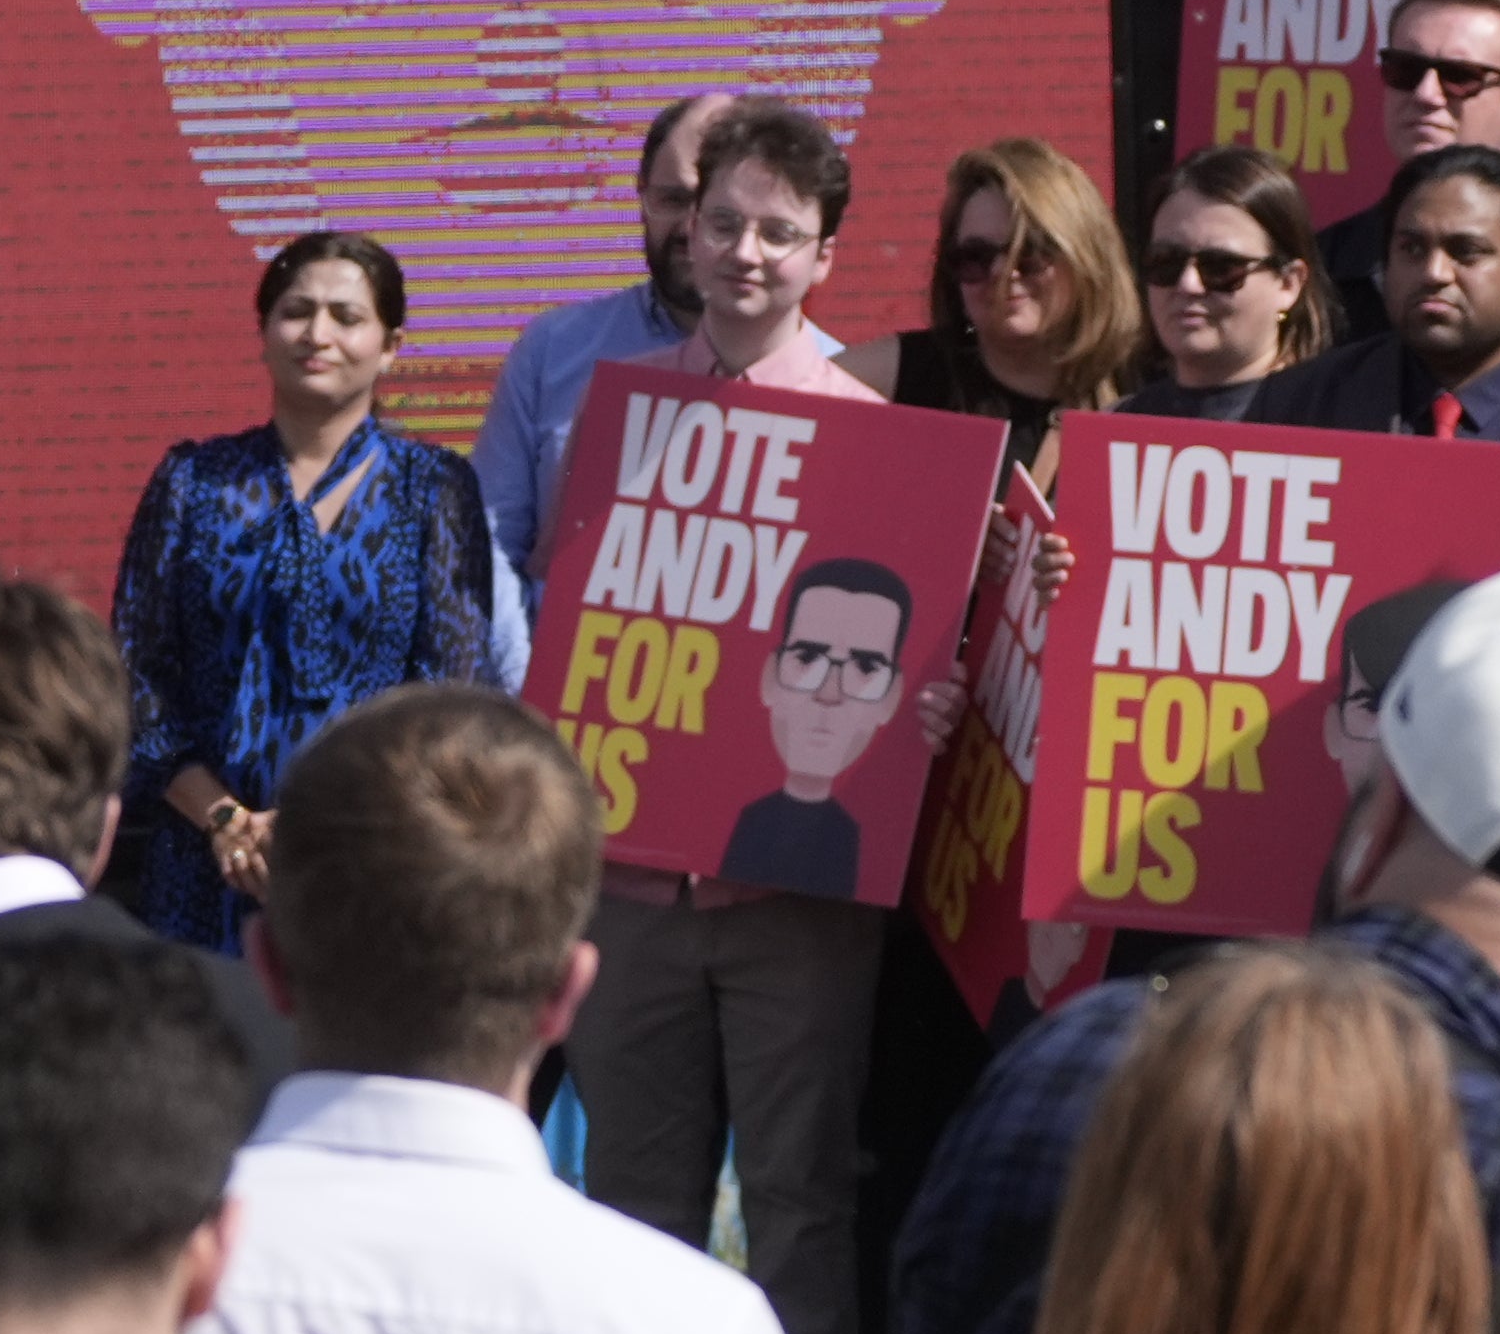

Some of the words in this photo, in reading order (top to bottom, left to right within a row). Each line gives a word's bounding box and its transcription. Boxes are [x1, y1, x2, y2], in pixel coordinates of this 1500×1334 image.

[1214, 66, 1352, 173] FOR
[616, 391, 817, 524] VOTE
[1109, 441, 1341, 566] VOTE
[582, 502, 809, 631] ANDY
[1092, 557, 1353, 682] ANDY
[560, 609, 720, 734] FOR
[1086, 672, 1269, 793] FOR
[949, 707, 1022, 882] FOR
[1078, 786, 1201, 904] US
